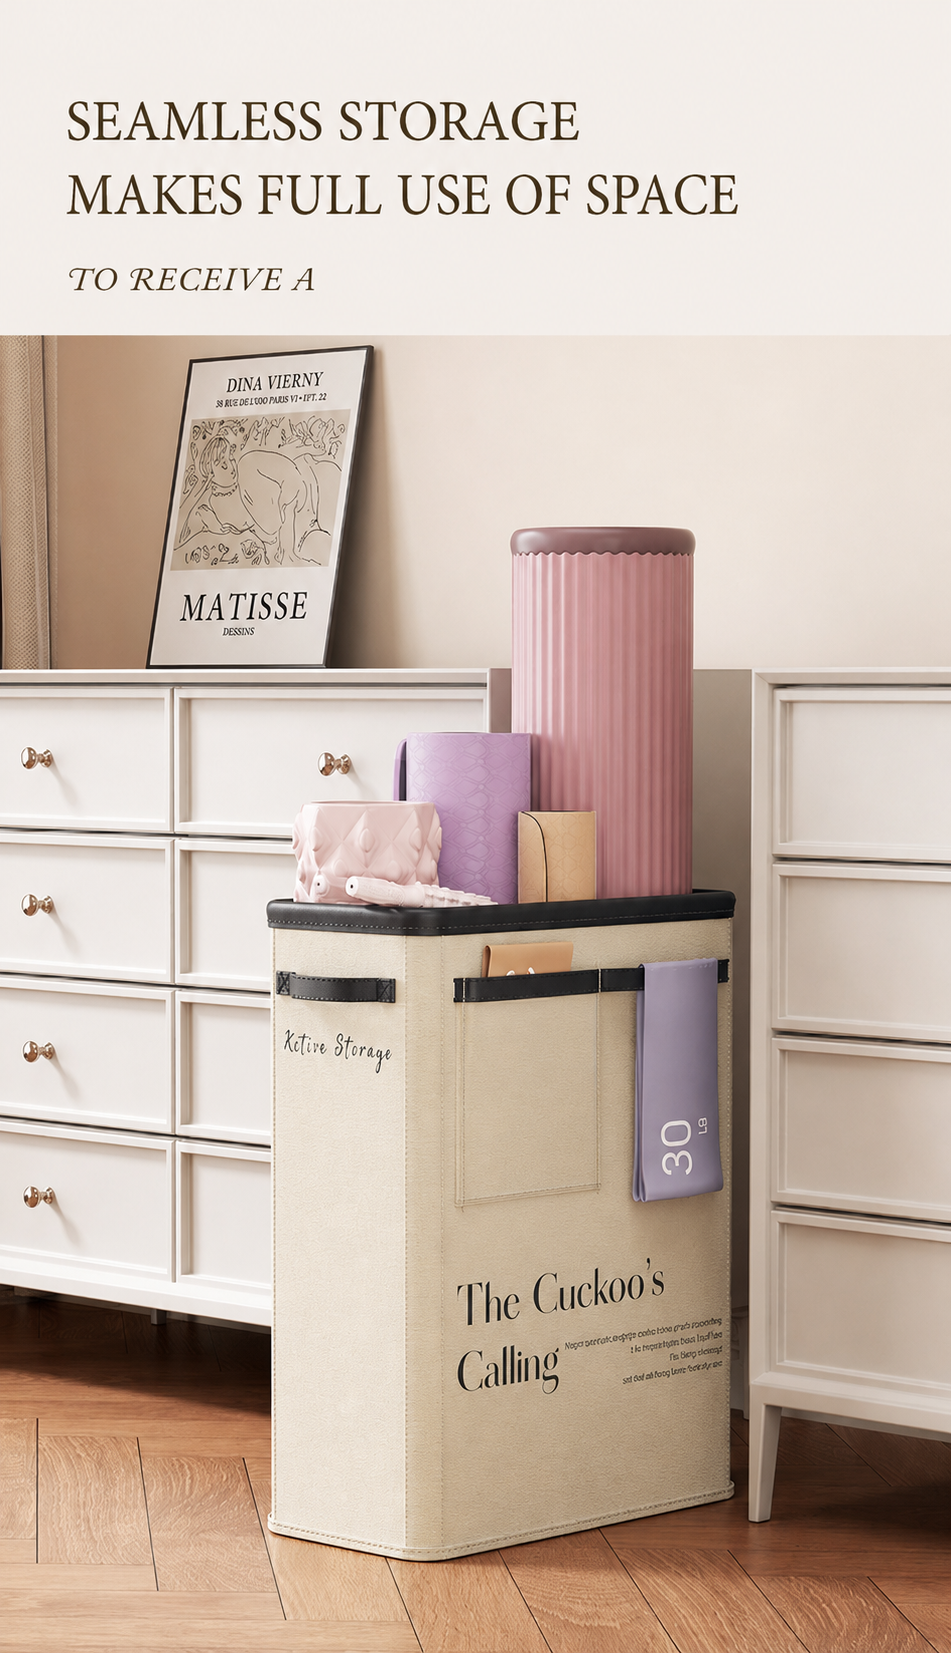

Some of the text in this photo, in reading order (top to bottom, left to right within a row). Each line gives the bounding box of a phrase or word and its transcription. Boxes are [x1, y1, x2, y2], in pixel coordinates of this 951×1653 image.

[226, 371, 324, 392] DINA VIERNY
[180, 591, 308, 622] MATISSE
[222, 626, 256, 637] DESSINS
[334, 1032, 393, 1074] Storage
[697, 1117, 708, 1135] LB
[660, 1119, 693, 1176] 30
[457, 1257, 665, 1326] The Cuckoo's
[457, 1345, 560, 1395] Calling
